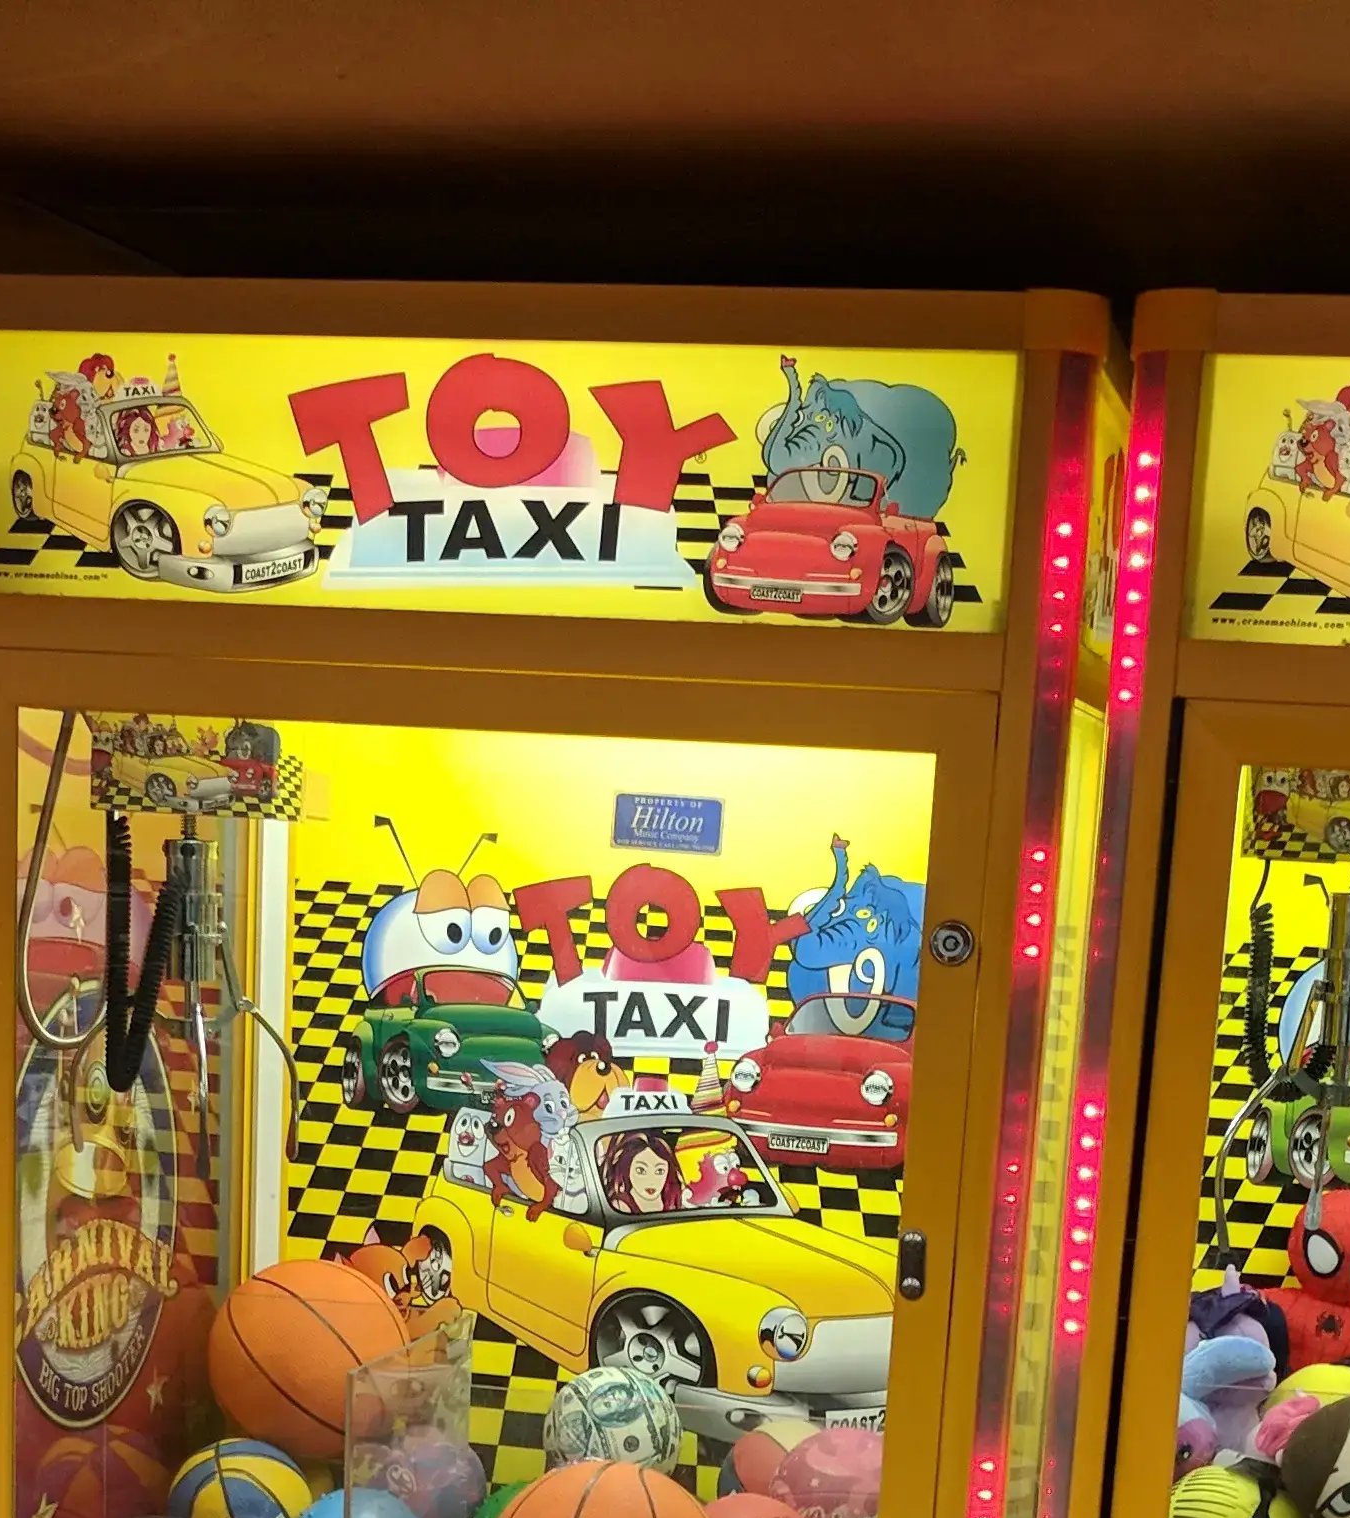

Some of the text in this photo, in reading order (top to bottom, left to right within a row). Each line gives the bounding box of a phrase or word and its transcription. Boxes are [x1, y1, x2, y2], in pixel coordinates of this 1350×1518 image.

[124, 386, 155, 397] TAXI
[288, 353, 738, 526] TOY
[389, 499, 620, 563] TAXI
[245, 558, 302, 581] COAST2COAST
[635, 797, 685, 808] PROPERTY
[631, 805, 705, 833] Hilton
[634, 828, 700, 844] Music Company
[512, 863, 813, 988] TOY
[584, 991, 731, 1043] TAXI
[621, 1094, 679, 1111] TAXI
[770, 1134, 828, 1152] COAST2COAST
[56, 1273, 129, 1349] KING
[39, 1325, 146, 1411] BIG TOP SHOOTER
